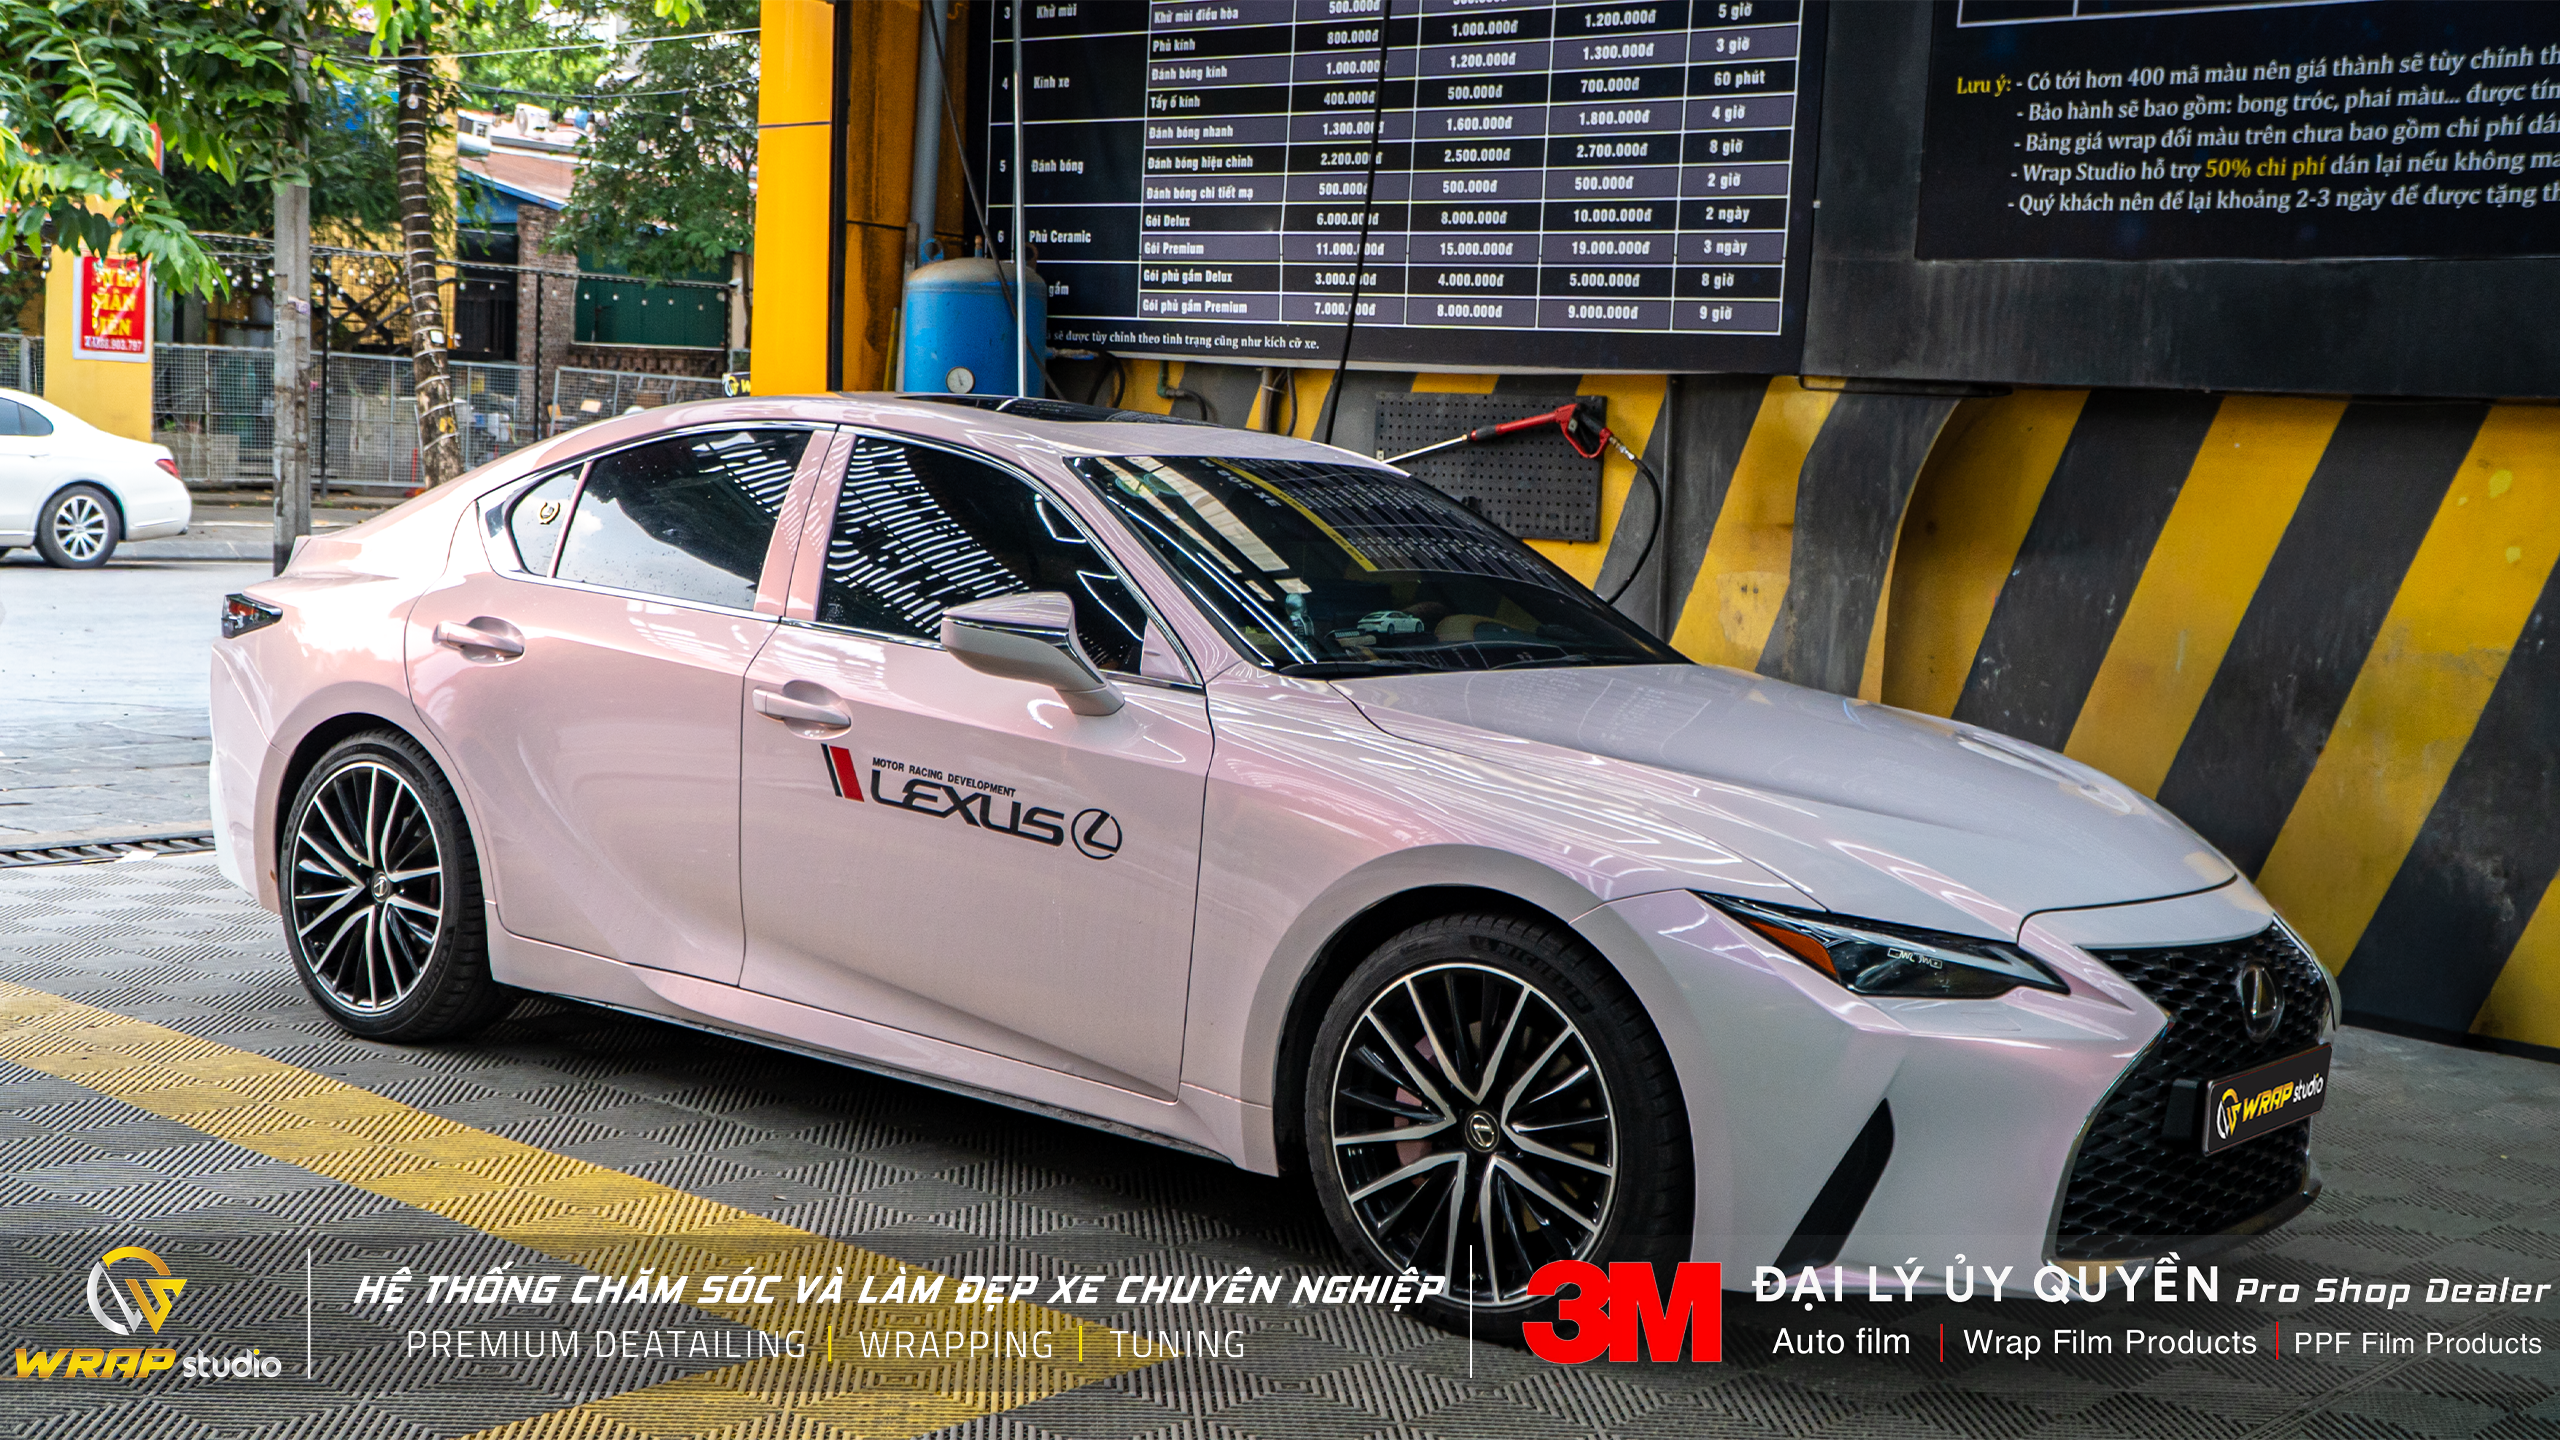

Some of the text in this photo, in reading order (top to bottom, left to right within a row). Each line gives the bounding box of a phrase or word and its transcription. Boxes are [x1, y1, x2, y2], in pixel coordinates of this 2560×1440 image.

[1585, 9, 1656, 27] 1.200.000đ
[1452, 20, 1518, 36] 1.000.000đ
[1327, 29, 1379, 45] 800.000đ
[1450, 52, 1517, 68] 1.200.000đ
[1583, 43, 1654, 61] 1.300.000đ
[1957, 77, 1990, 94] Lưu
[1995, 74, 2011, 97] ý:
[2028, 71, 2051, 91] Có
[2056, 70, 2081, 89] tới
[2086, 69, 2122, 88] hơn
[2128, 67, 2165, 87] 400
[2170, 68, 2199, 85] mã
[2205, 63, 2247, 83] màu
[2253, 60, 2291, 80] nên
[2295, 57, 2326, 83] giá
[2333, 53, 2394, 76] thành
[2399, 53, 2423, 73] sẽ
[2429, 51, 2466, 76] tùy
[2470, 45, 2533, 69] chỉnh
[1058, 77, 1070, 88] xe
[1581, 77, 1640, 93] 700.000đ
[1714, 70, 1766, 89] 60 phút
[1324, 91, 1376, 105] 400.000đ
[1448, 84, 1503, 100] 500.000đ
[2029, 102, 2062, 121] Bảo
[2067, 100, 2113, 119] hành
[2118, 100, 2139, 118] sẽ
[2144, 98, 2178, 117] bao
[2182, 95, 2231, 120] gồm:
[2237, 94, 2288, 117] bong
[2293, 90, 2339, 111] tróc,
[2344, 88, 2391, 114] phai
[2397, 86, 2460, 106] màu...
[2466, 83, 2526, 106] được
[1446, 116, 1513, 131] 1.600.000đ
[1579, 110, 1650, 126] 1.800.000đ
[2026, 132, 2071, 155] Bảng
[2074, 131, 2102, 155] giá
[2108, 135, 2156, 153] wrap
[2161, 127, 2192, 148] đổi
[2197, 127, 2239, 146] màu
[2246, 125, 2286, 145] trên
[2292, 123, 2343, 143] chưa
[2349, 121, 2388, 141] bao
[2392, 118, 2440, 145] gồm
[2446, 117, 2479, 138] chi
[2484, 114, 2524, 142] phí
[1444, 148, 1511, 163] 2.500.000đ
[1576, 143, 1648, 159] 2.700.000đ
[1031, 159, 1084, 174] Đánh bóng
[2023, 164, 2072, 186] Wrap
[2076, 162, 2136, 181] Studio
[2141, 158, 2165, 179] hỗ
[2171, 163, 2201, 182] trợ
[2206, 159, 2251, 177] 50%
[2257, 157, 2286, 176] chi
[2292, 156, 2326, 180] phí
[2330, 154, 2369, 174] dán
[2375, 153, 2401, 177] lại
[2407, 150, 2448, 172] nếu
[2454, 150, 2525, 175] không
[1443, 180, 1498, 194] 500.000đ
[1575, 176, 1634, 190] 500.000đ
[2019, 193, 2055, 216] Quý
[2059, 192, 2113, 211] khách
[2119, 192, 2154, 211] nên
[2159, 190, 2184, 210] để
[2188, 190, 2211, 213] lại
[2217, 189, 2291, 213] khoảng
[2296, 188, 2330, 208] 2-3
[2336, 187, 2387, 211] ngày
[2391, 184, 2419, 205] để
[2423, 185, 2481, 209] được
[2487, 184, 2537, 208] tặng
[1145, 214, 1190, 227] Gói Delux
[1441, 211, 1507, 225] 8.000.000đ
[1574, 208, 1652, 223] 10.000.000đ
[1706, 206, 1750, 223] 2 ngày
[1051, 230, 1091, 243] Ceramic
[1145, 241, 1204, 255] Gói Premium
[1440, 242, 1513, 256] 15.000.000đ
[1572, 241, 1650, 255] 19.000.000đ
[1704, 240, 1747, 256] 3 ngày
[1438, 273, 1504, 287] 4.000.000đ
[1570, 273, 1640, 287] 5.000.000đ
[1437, 304, 1503, 318] 8.000.000đ
[1568, 305, 1638, 320] 9.000.000đ
[1139, 332, 1160, 344] theo
[1241, 335, 1262, 347] như
[1305, 340, 1319, 349] xe.
[872, 757, 1016, 798] MOTOR RACING DEVELOPMENT
[871, 769, 1065, 847] LEXUS
[2242, 1073, 2324, 1122] WRAP studio
